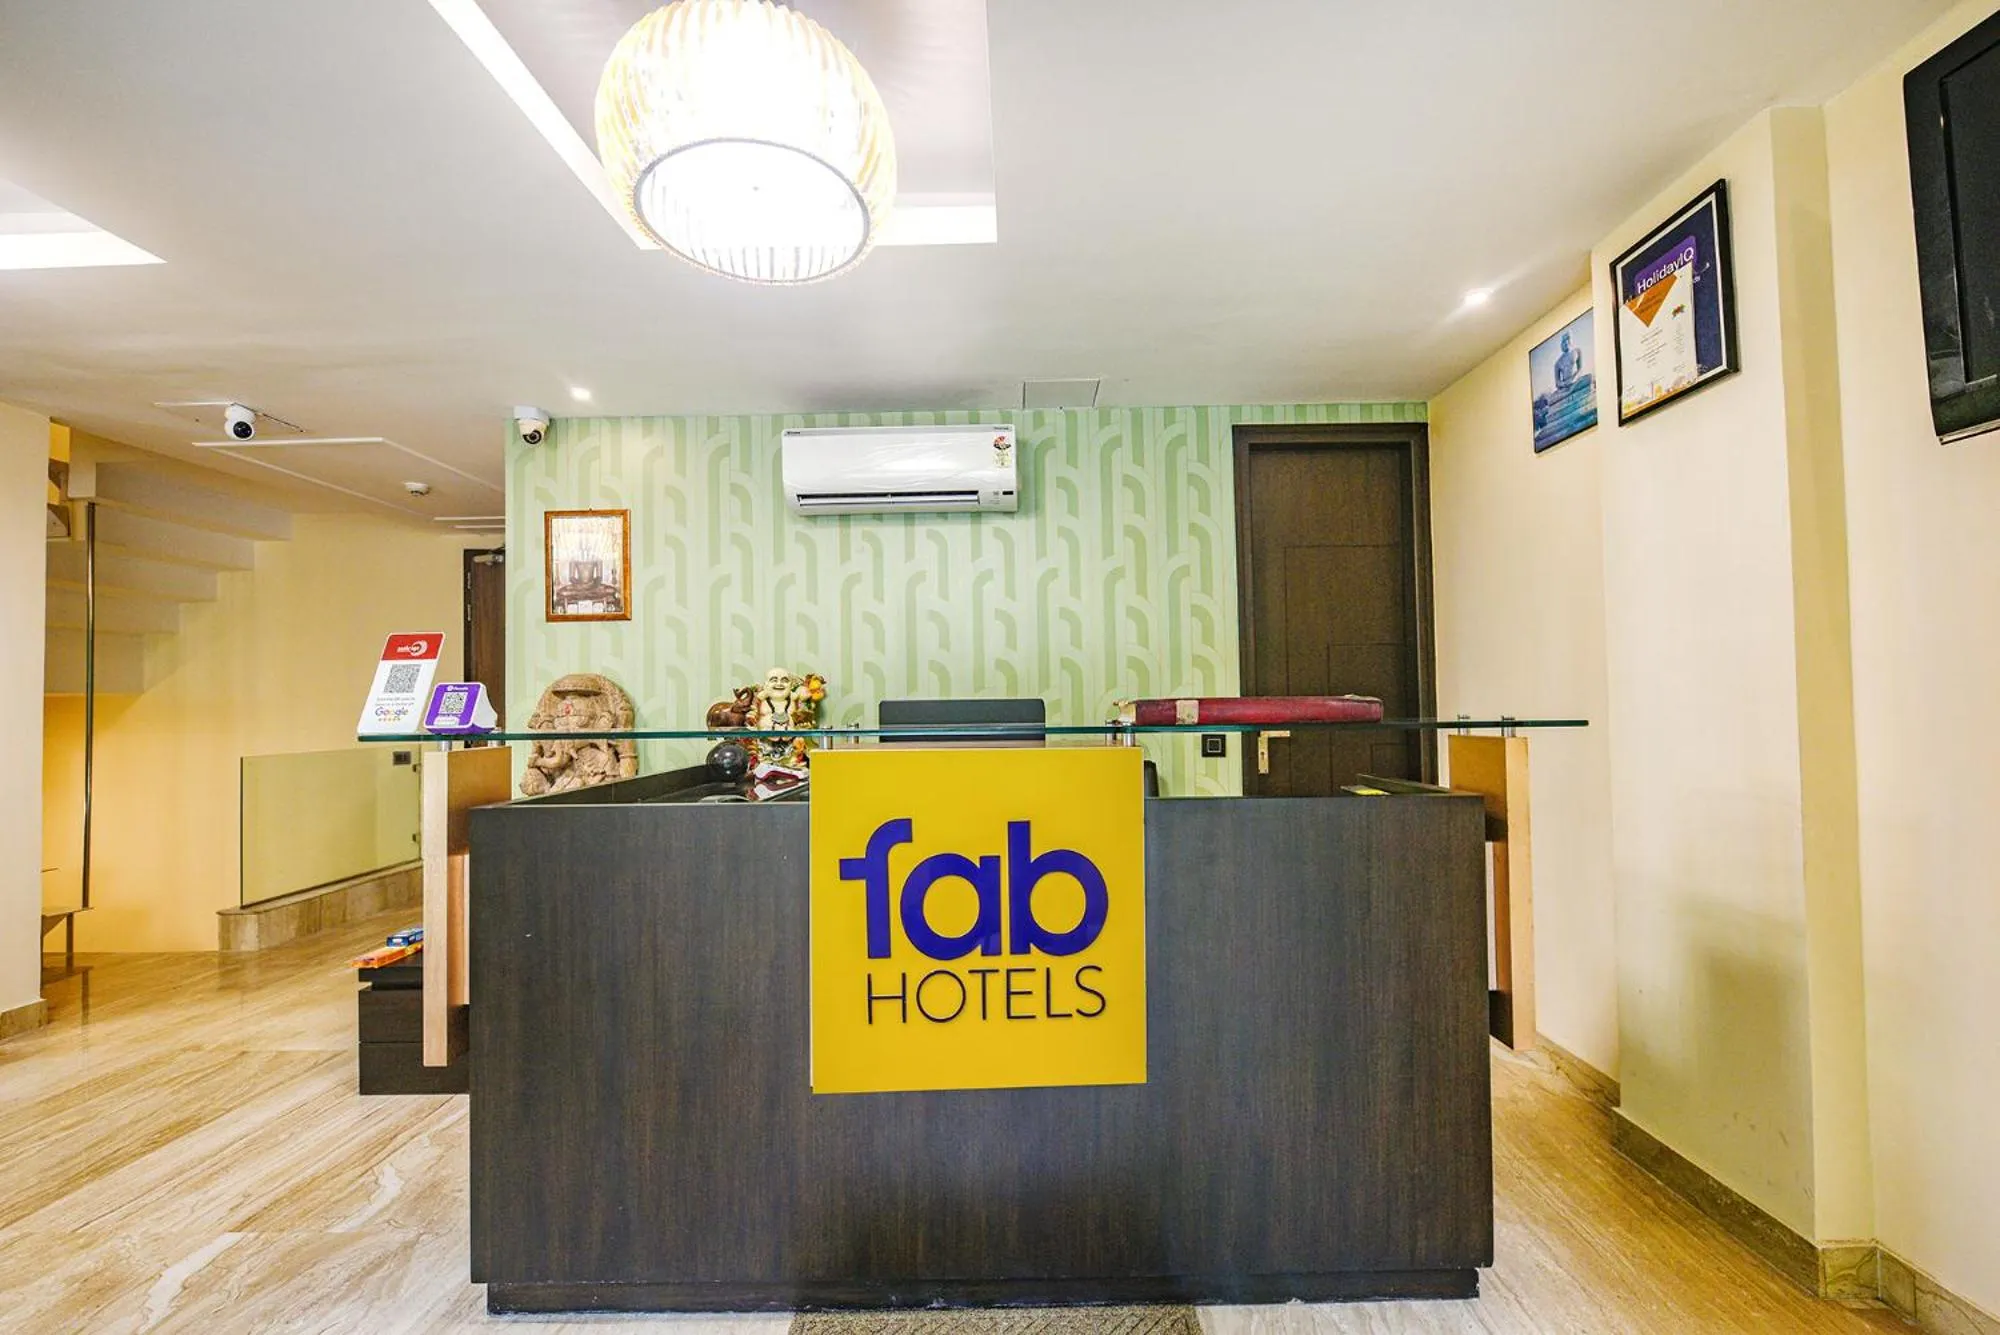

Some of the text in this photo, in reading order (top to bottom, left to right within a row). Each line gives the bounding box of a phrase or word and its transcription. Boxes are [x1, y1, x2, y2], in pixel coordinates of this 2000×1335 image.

[1636, 246, 1695, 294] HolidayIQ
[839, 817, 1109, 961] fab
[866, 965, 1107, 1025] HOTELS
